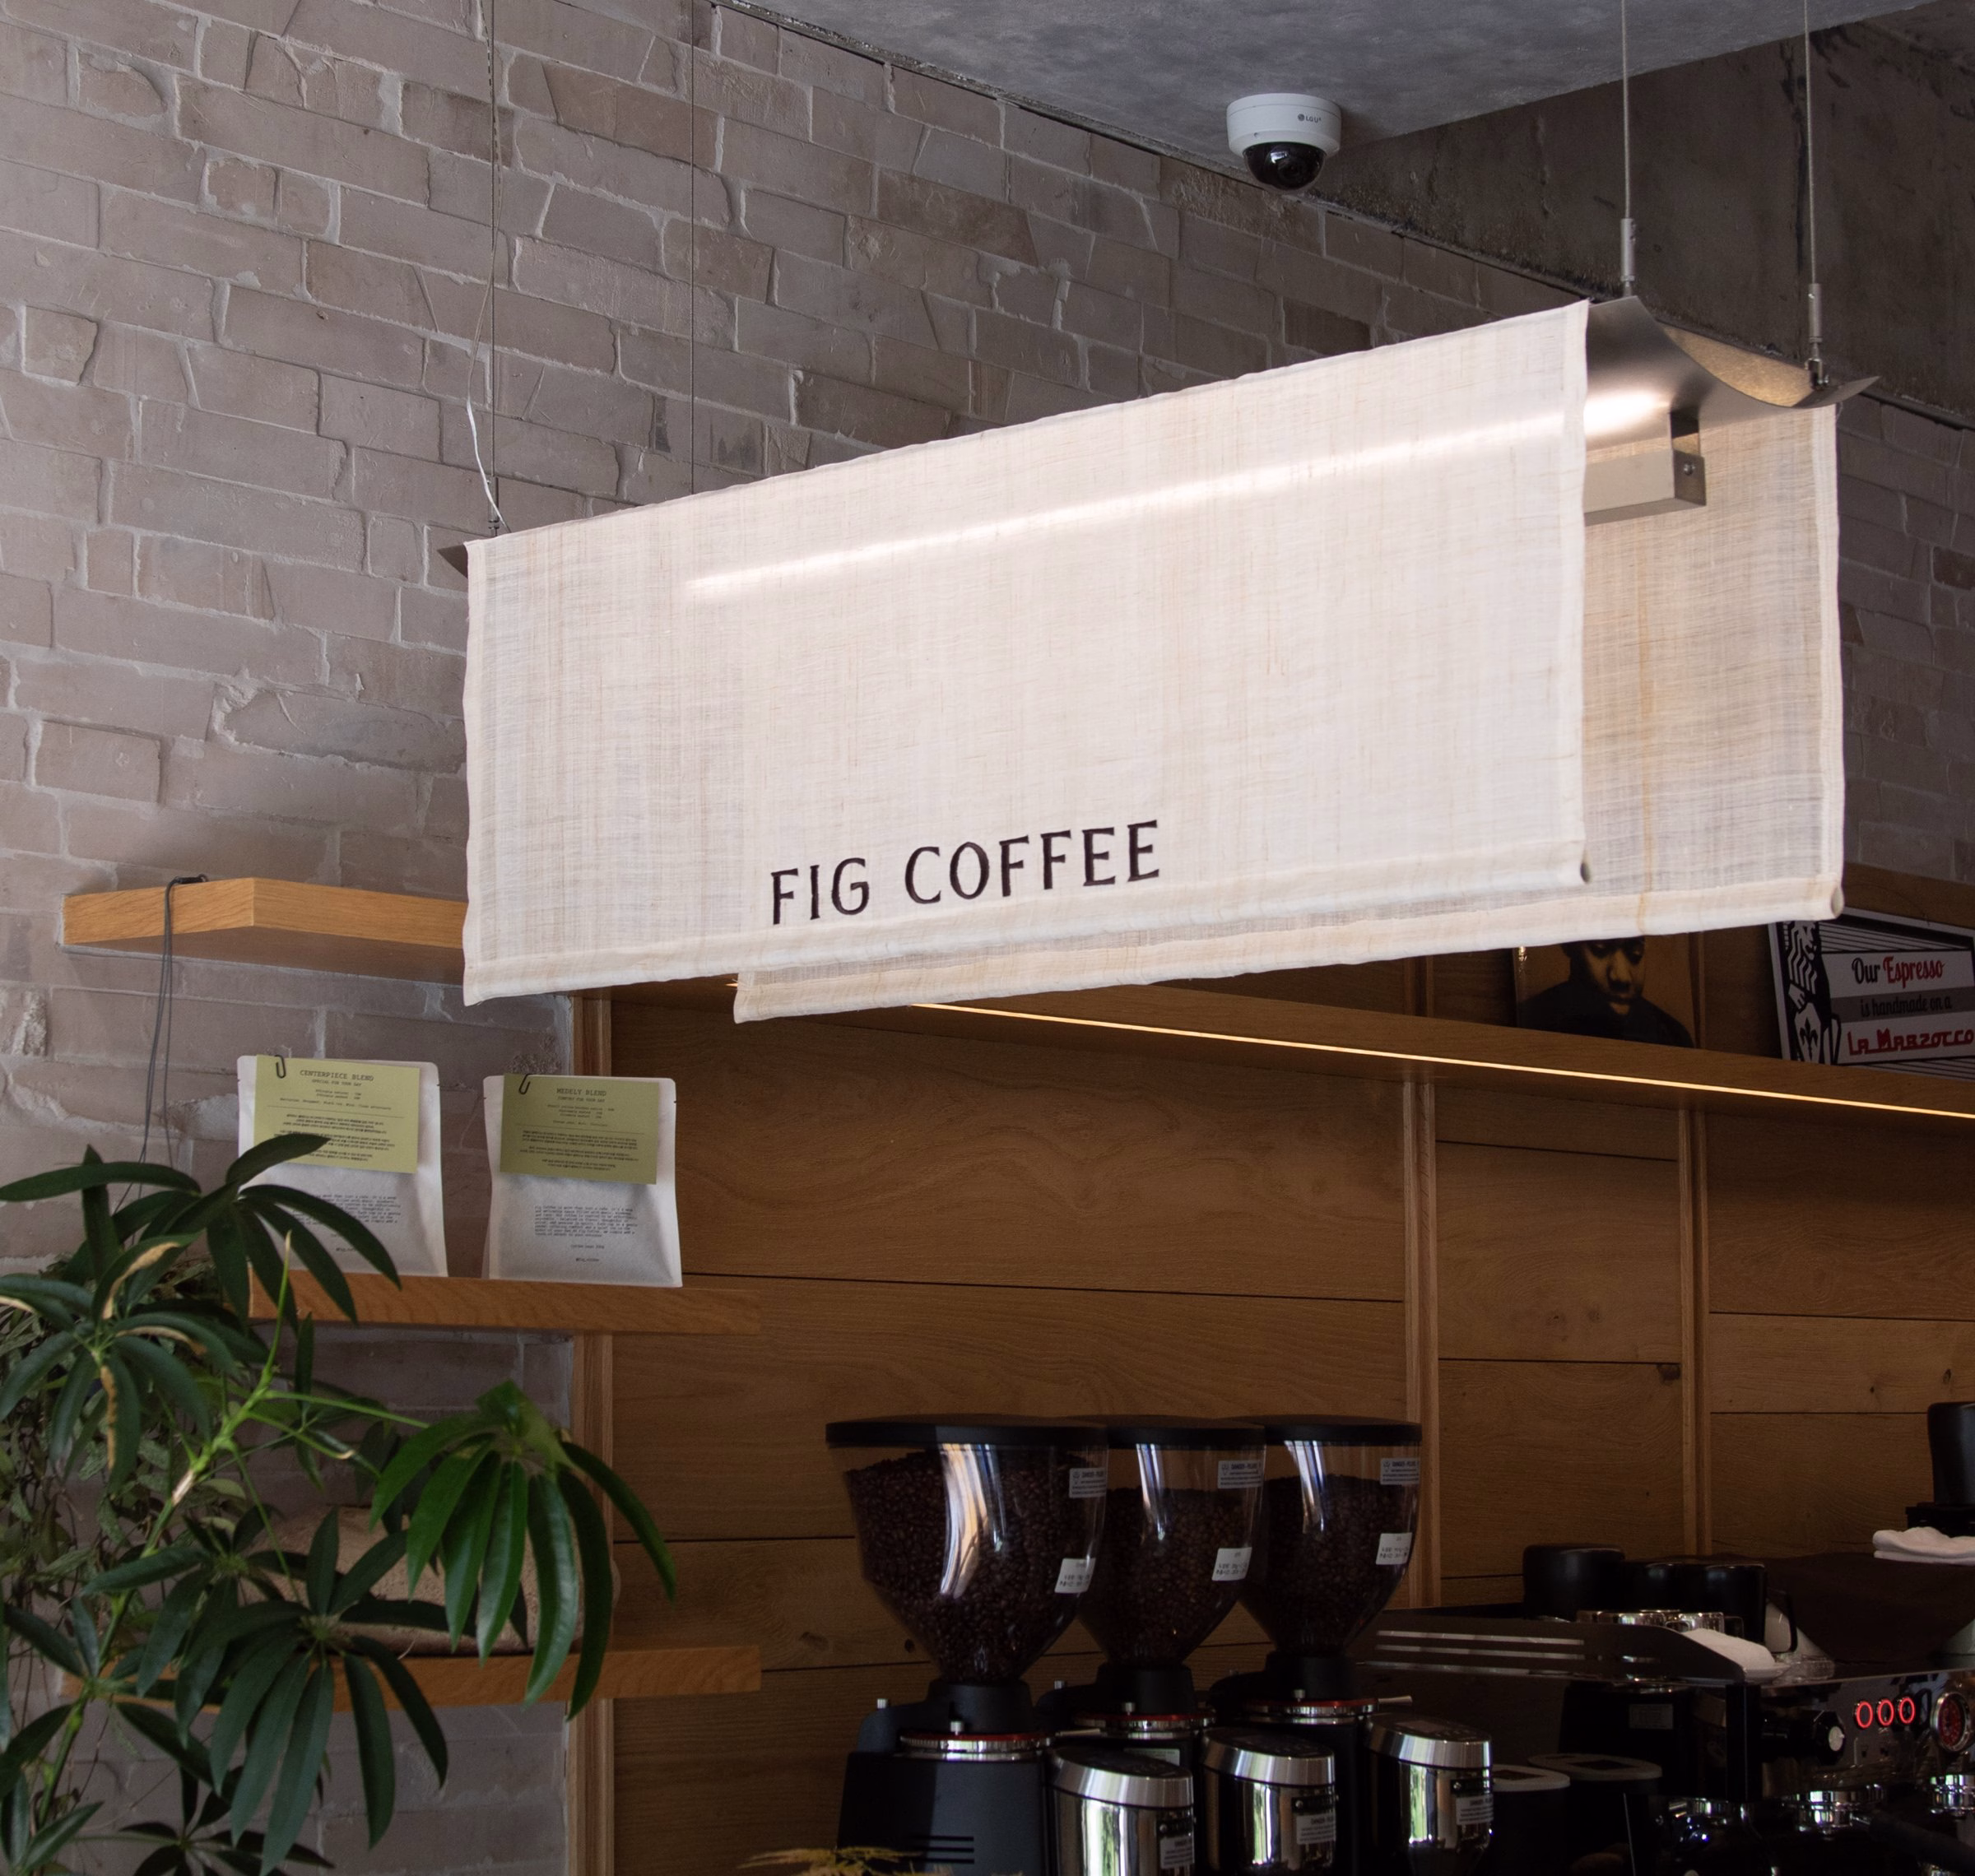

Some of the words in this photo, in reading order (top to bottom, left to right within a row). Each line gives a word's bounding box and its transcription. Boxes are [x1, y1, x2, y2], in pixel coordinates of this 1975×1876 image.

[770, 857, 870, 925] FIG
[905, 820, 1159, 904] COFFEE
[1852, 957, 1880, 984] Our
[1882, 956, 1945, 988] Espresso
[1860, 999, 1870, 1018] is
[1871, 994, 1928, 1017] handmade
[1930, 997, 1943, 1010] on
[1945, 996, 1953, 1009] a
[300, 1070, 348, 1080] CENTERPIECE
[351, 1073, 374, 1082] BLEND
